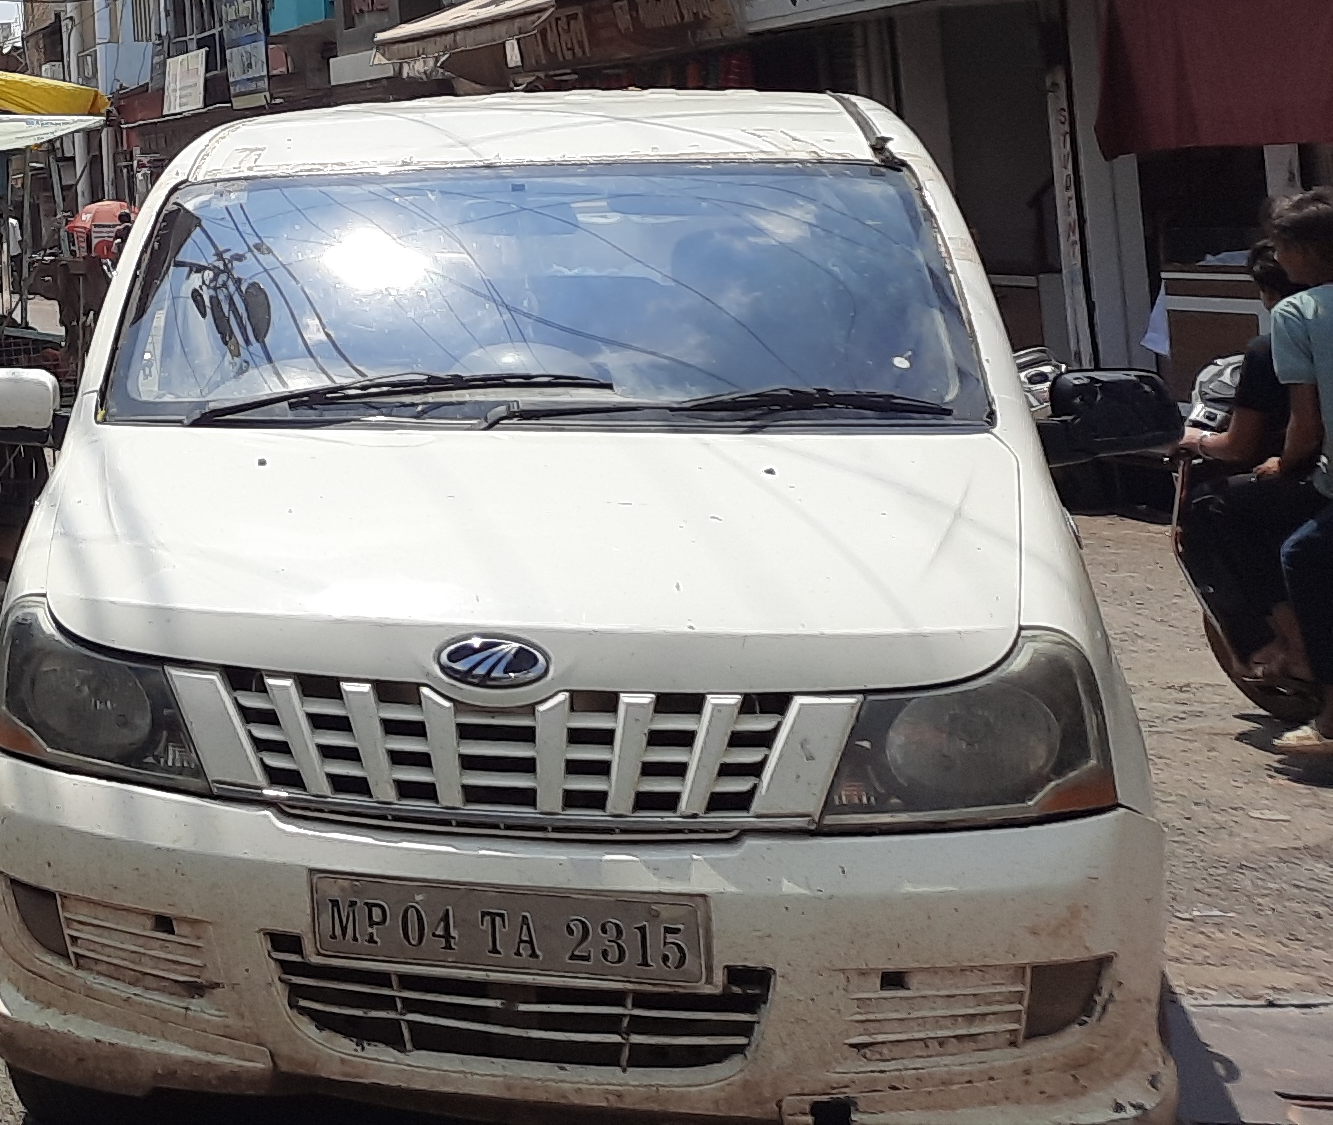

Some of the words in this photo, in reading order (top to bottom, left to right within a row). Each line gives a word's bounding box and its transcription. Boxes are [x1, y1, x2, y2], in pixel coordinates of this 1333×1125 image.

[328, 898, 390, 946] MP
[399, 902, 457, 951] 04
[480, 909, 541, 960] TA
[565, 916, 688, 971] 2315
